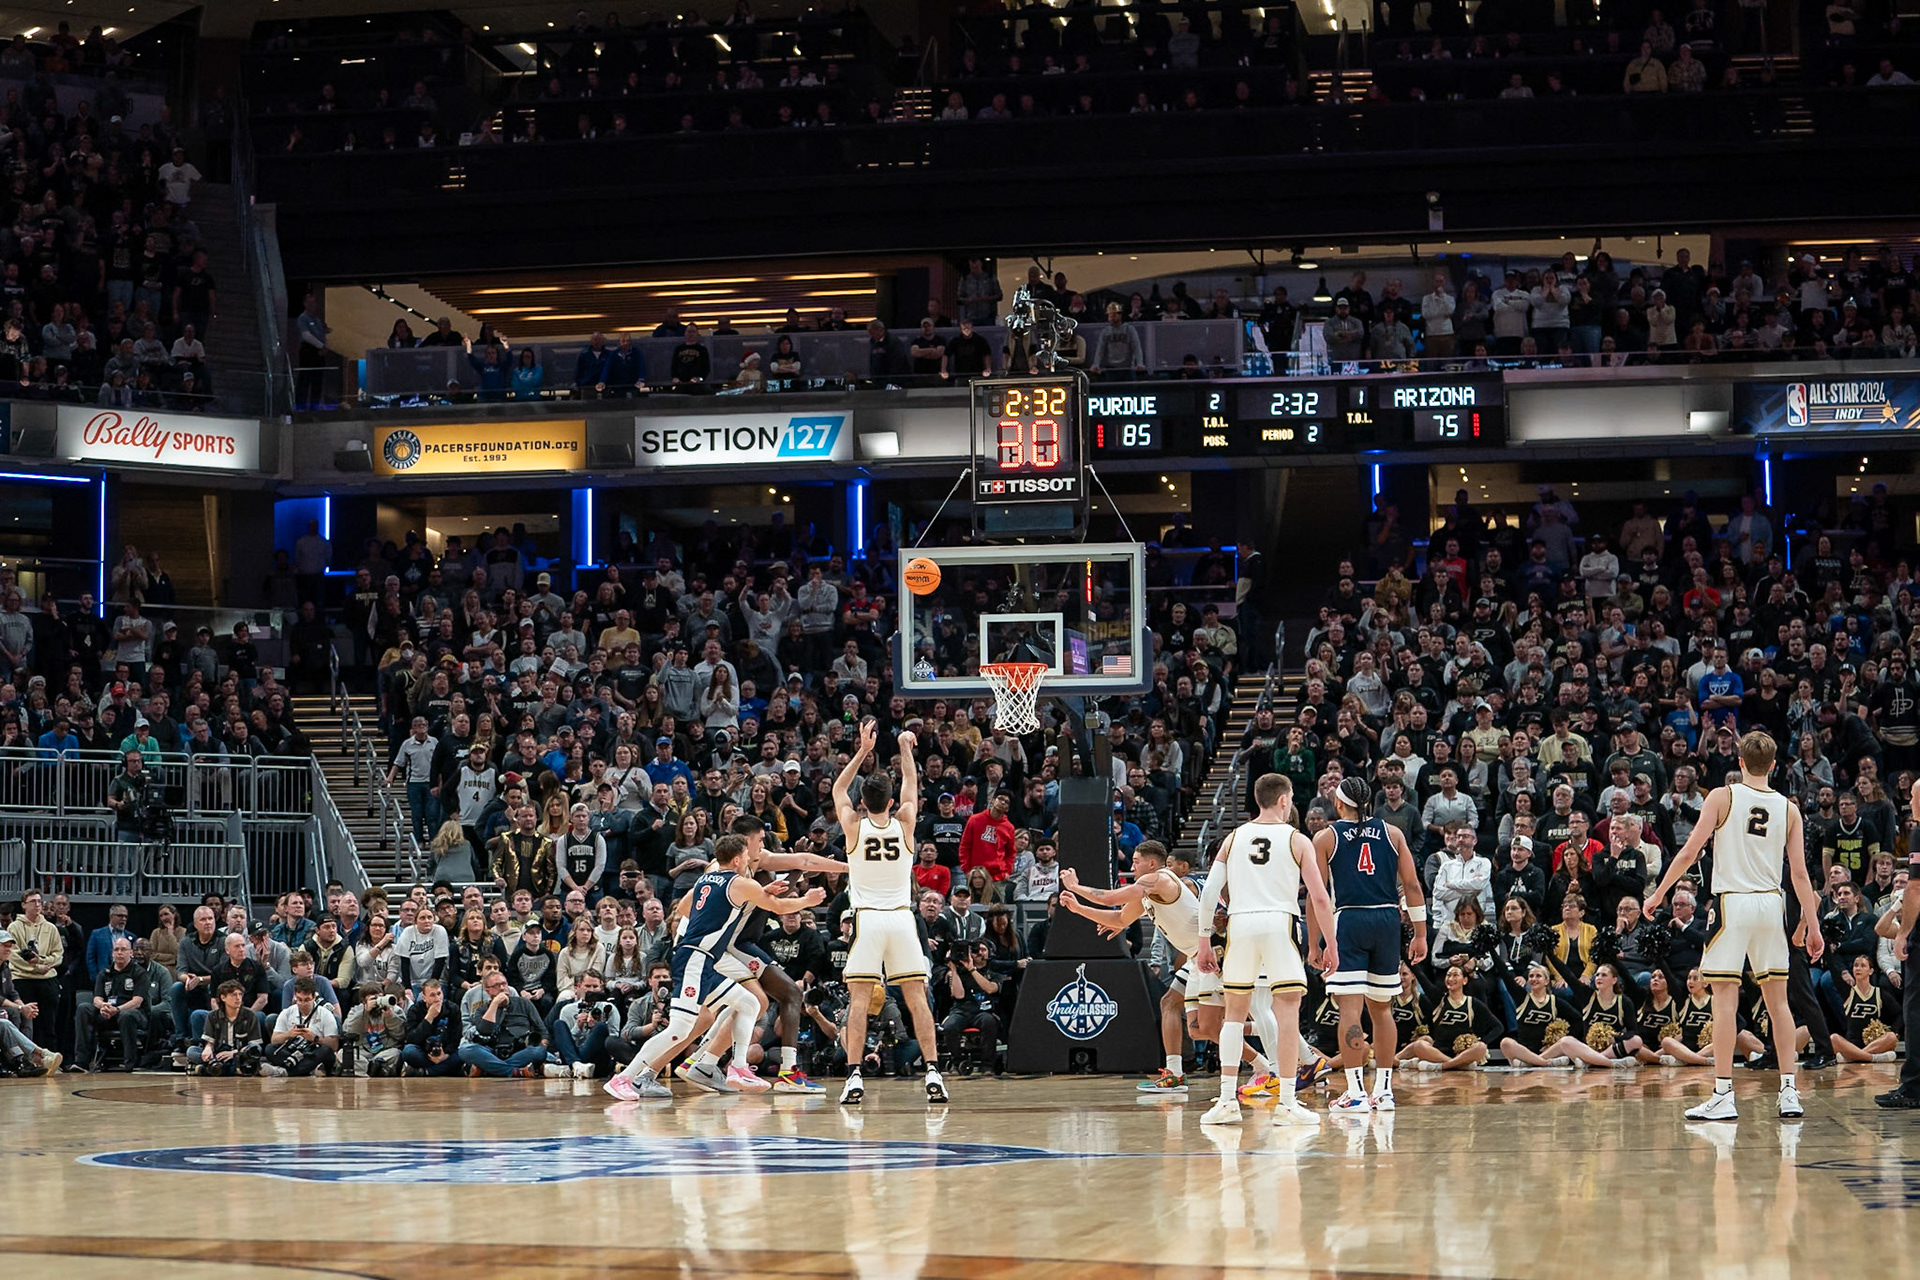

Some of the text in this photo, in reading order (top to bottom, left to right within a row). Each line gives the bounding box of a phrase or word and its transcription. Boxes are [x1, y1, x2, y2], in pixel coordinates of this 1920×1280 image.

[1358, 390, 1365, 405] 1
[1394, 387, 1476, 407] ARIZONA
[1860, 382, 1886, 403] 2024
[1005, 388, 1066, 417] 2:32
[1088, 396, 1157, 416] PURDUE
[1209, 393, 1220, 410] 2
[1270, 392, 1319, 416] 2:32
[1203, 416, 1228, 428] T.O.L.
[1346, 412, 1373, 424] T.O.L.
[1835, 408, 1863, 420] INDY
[1307, 425, 1318, 442] 2
[1432, 414, 1459, 437] 75
[83, 411, 236, 459] Bally SPORTS
[641, 424, 832, 454] SECTION 127
[1123, 423, 1151, 447] 85
[1203, 435, 1229, 447] POSS.
[1262, 428, 1294, 441] PERIOD
[424, 440, 578, 453] PACERSFOUNDATION.org
[998, 419, 1060, 469] 30
[1006, 478, 1076, 493] TISSOT
[463, 780, 491, 790] PURDUE
[472, 791, 480, 803] 4
[1747, 804, 1770, 838] 2
[568, 844, 594, 857] PURDUE
[864, 837, 900, 862] 25
[1249, 836, 1272, 866] 3
[1837, 839, 1863, 850] PURDUE
[574, 859, 587, 873] 15
[1357, 842, 1376, 876] 4
[1839, 852, 1862, 870] 55
[695, 884, 711, 911] 3
[1048, 1001, 1117, 1019] Indy CLASSIC
[1439, 1010, 1468, 1025] P
[1524, 1010, 1553, 1024] P
[1850, 1003, 1877, 1019] P
[1643, 1014, 1671, 1028] P
